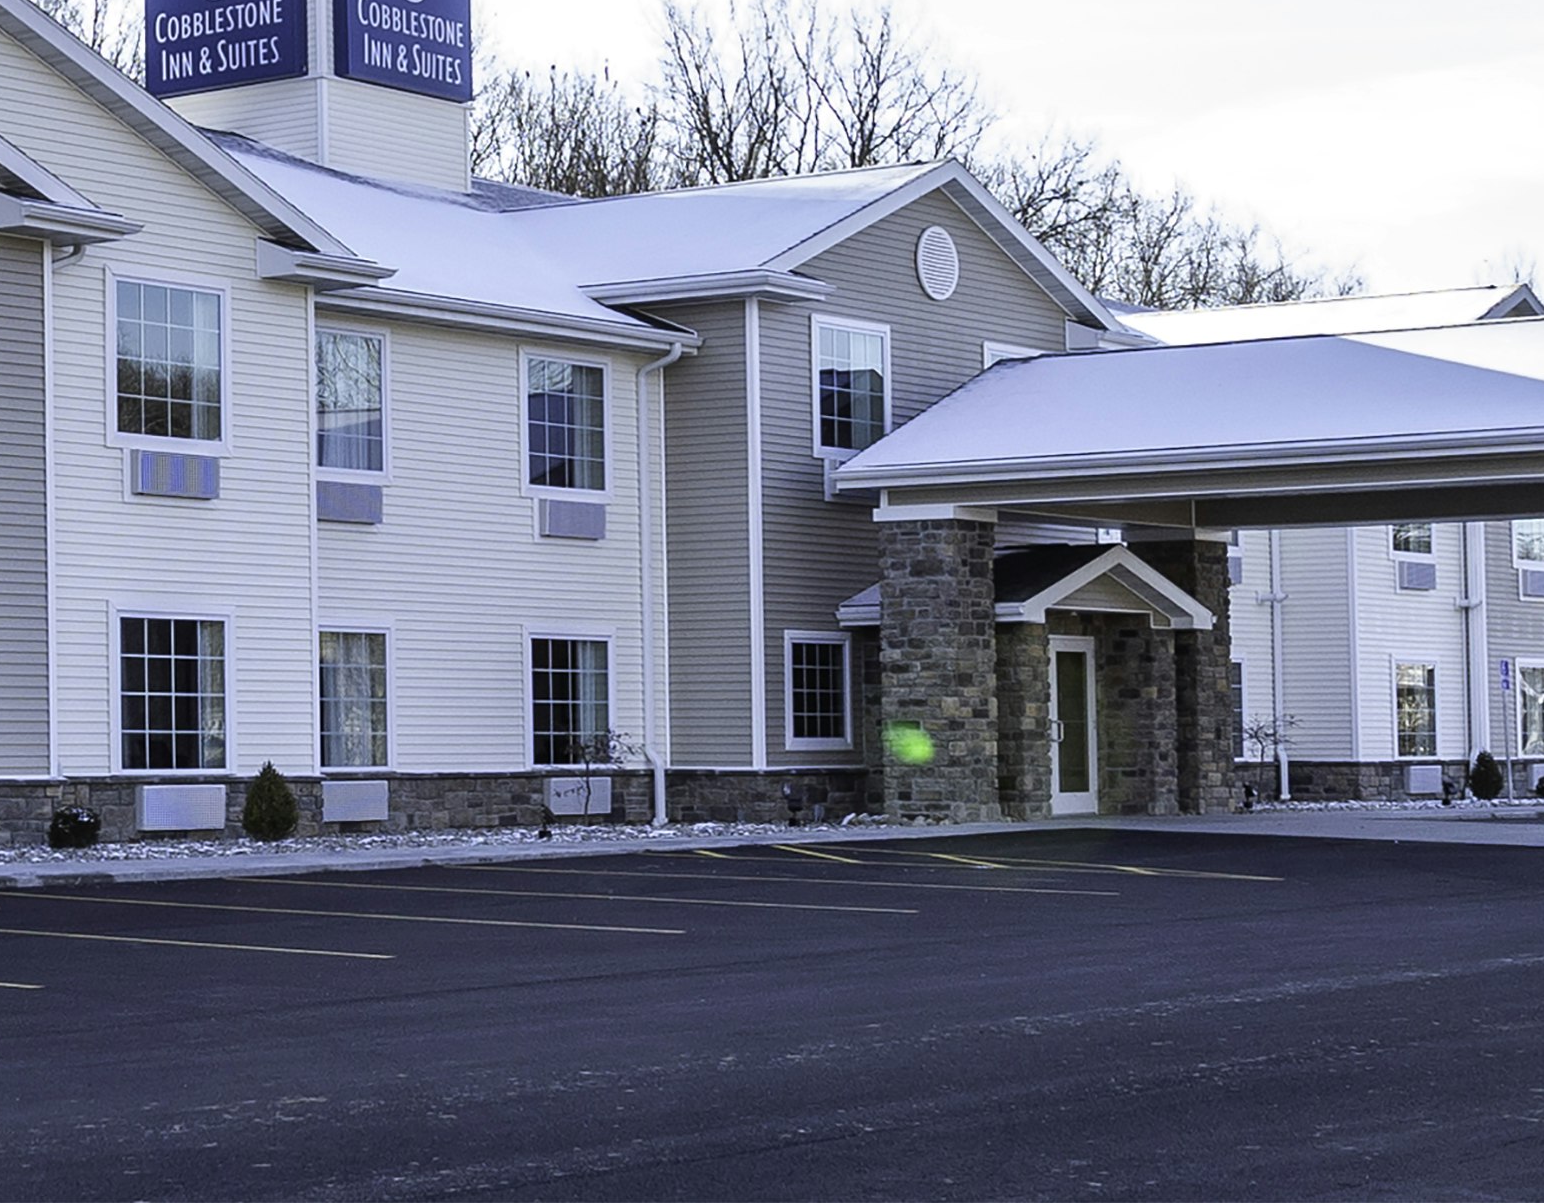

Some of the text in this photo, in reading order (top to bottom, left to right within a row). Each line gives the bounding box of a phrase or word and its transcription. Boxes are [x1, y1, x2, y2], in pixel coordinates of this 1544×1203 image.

[161, 36, 279, 81] INN & SUITES
[364, 32, 462, 85] INN & SUITES
